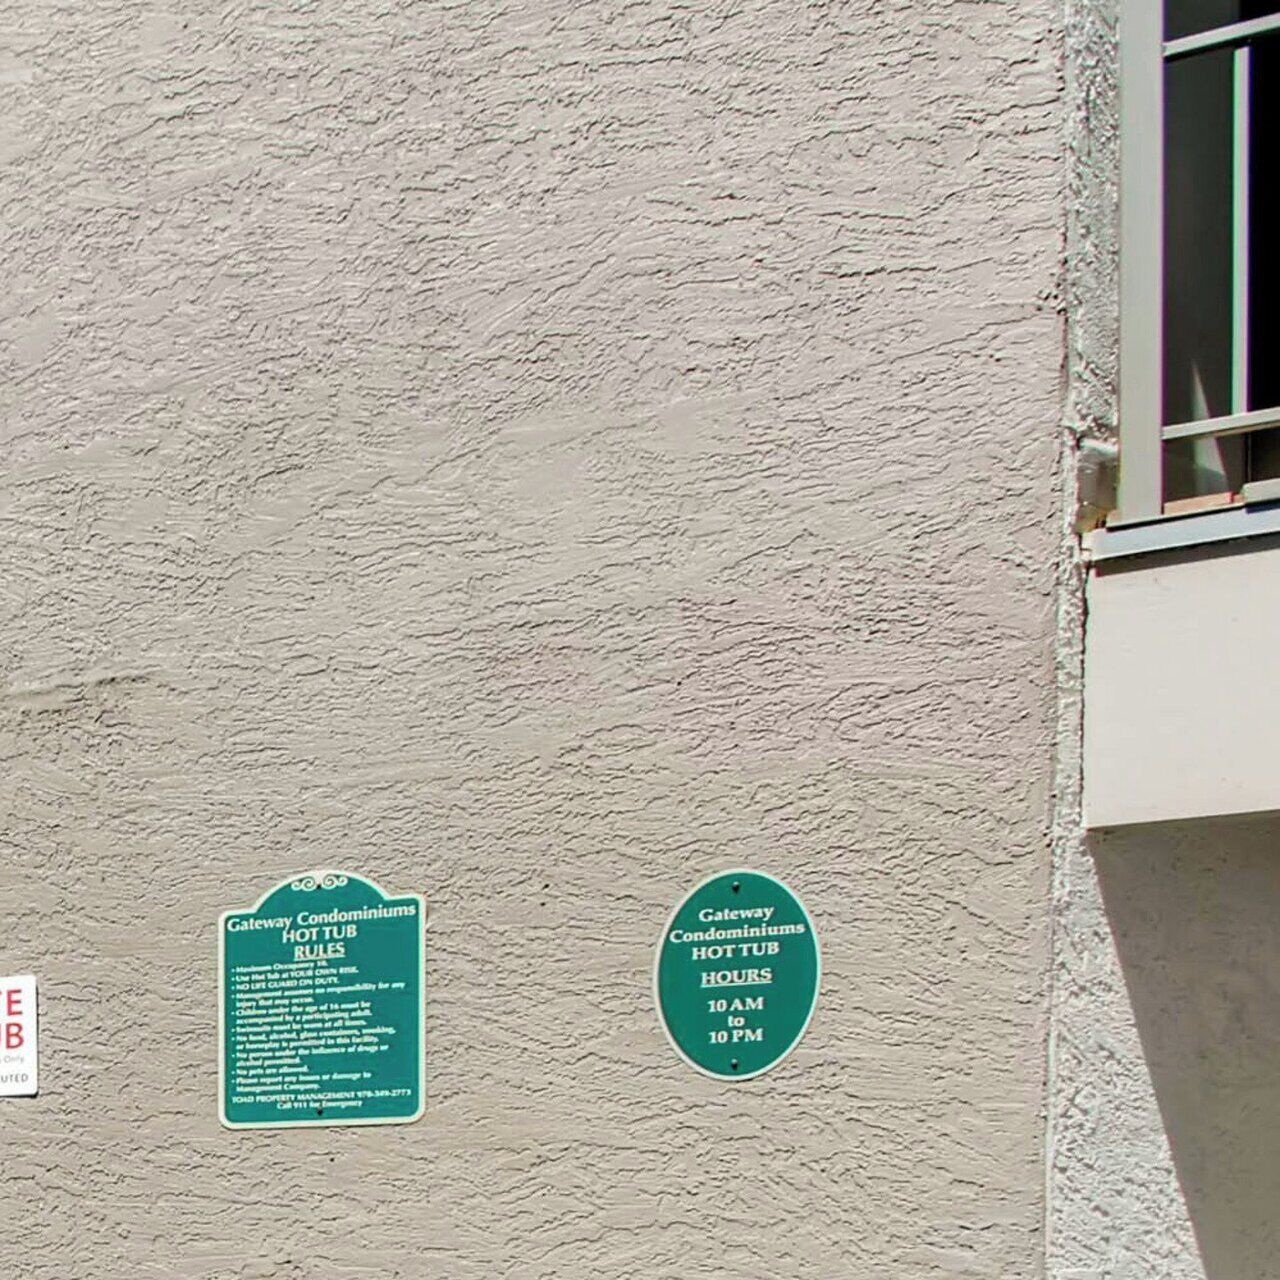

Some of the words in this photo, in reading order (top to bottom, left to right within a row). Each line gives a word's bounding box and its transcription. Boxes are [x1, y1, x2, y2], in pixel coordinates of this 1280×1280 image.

[227, 916, 291, 934] Gateway
[297, 903, 417, 926] Condominiums
[698, 906, 774, 922] Gateway
[282, 926, 320, 943] HOT
[323, 924, 357, 940] TUB
[669, 922, 806, 943] Condominiums
[294, 942, 345, 959] RULES
[692, 945, 736, 961] HOT
[738, 942, 780, 956] TUB
[701, 968, 772, 985] HOURS
[709, 1000, 728, 1012] 10
[730, 997, 764, 1011] AM
[727, 1014, 745, 1027] to
[709, 1031, 728, 1044] 10
[732, 1028, 763, 1042] PM
